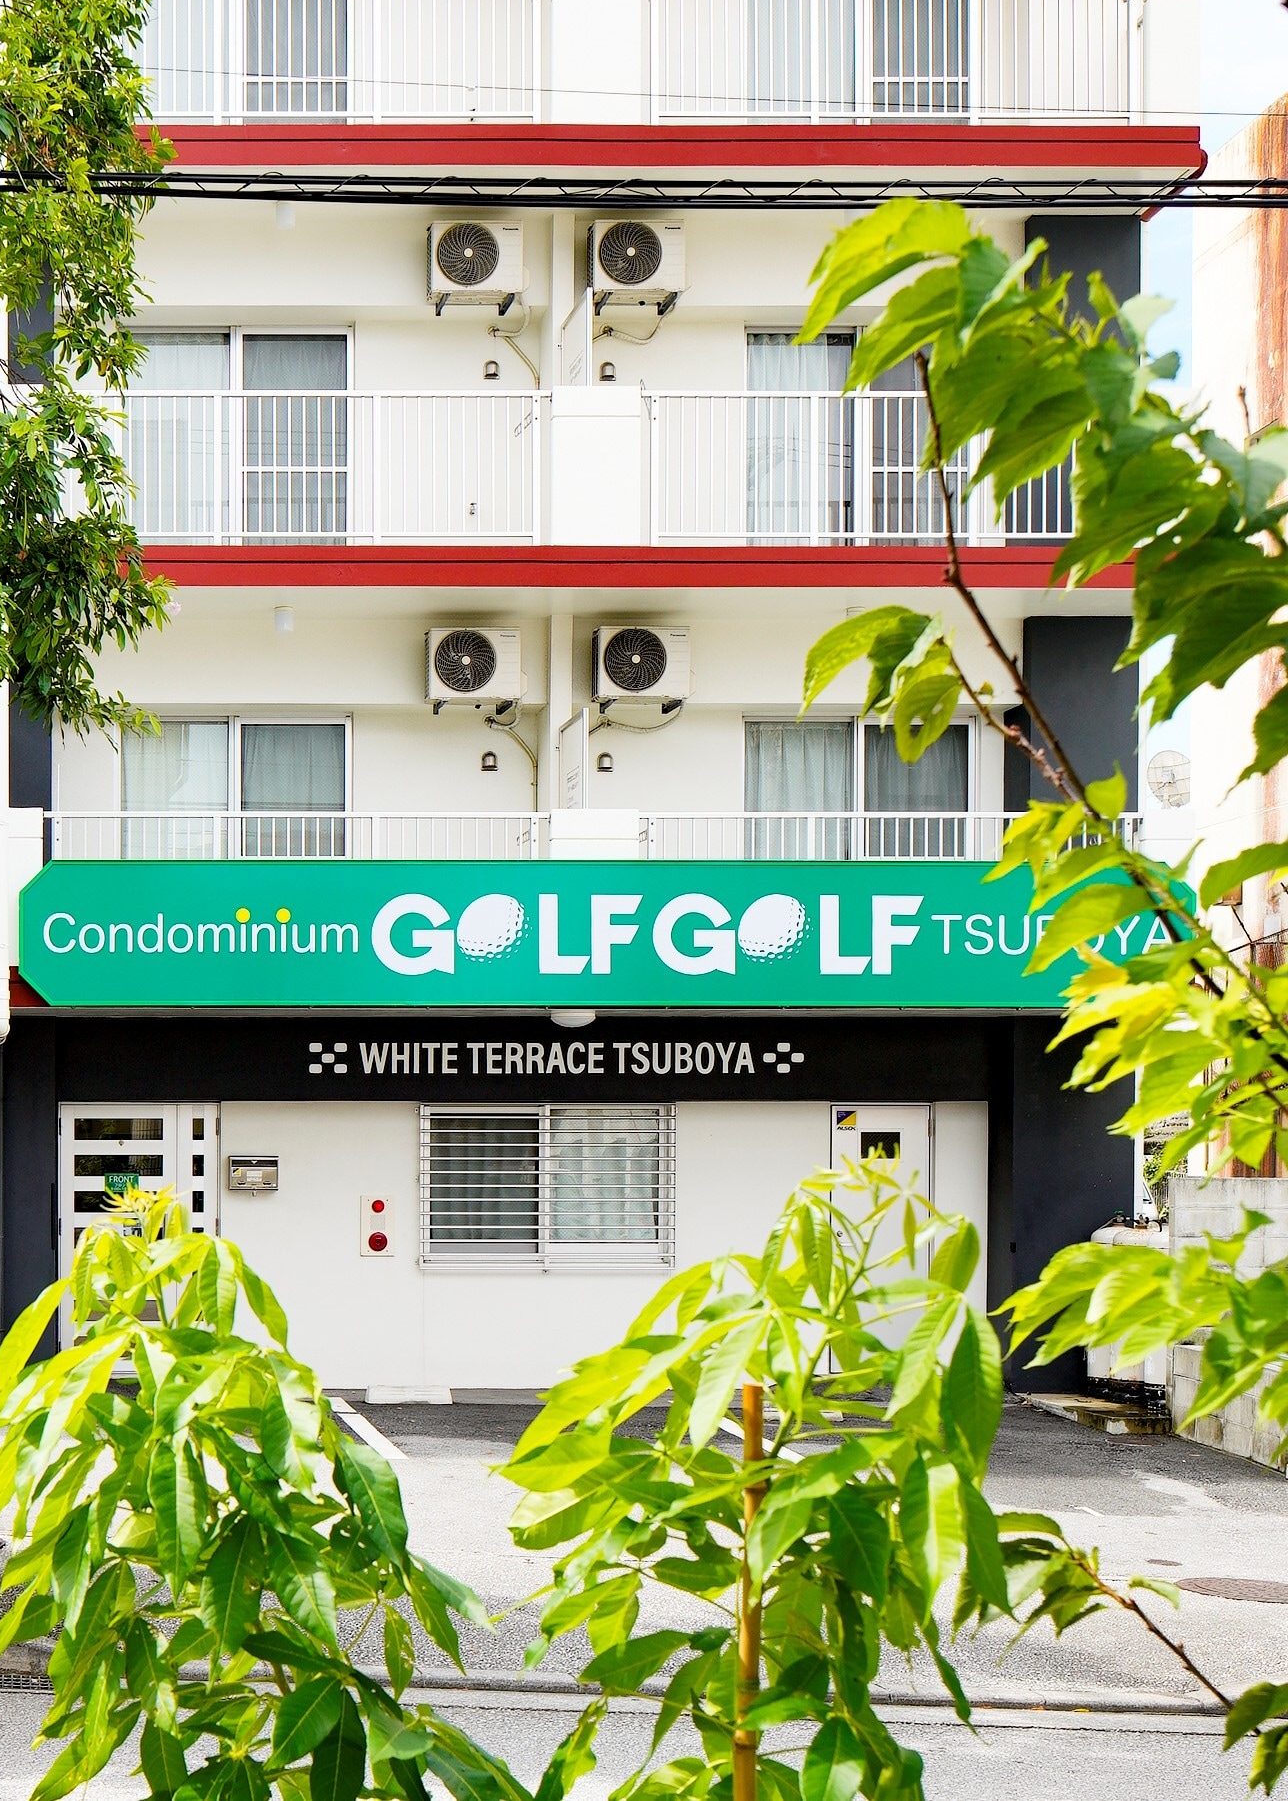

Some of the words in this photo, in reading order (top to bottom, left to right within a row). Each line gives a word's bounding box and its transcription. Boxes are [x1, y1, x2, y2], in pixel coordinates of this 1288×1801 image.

[43, 907, 359, 954] Condominium
[358, 1041, 459, 1075] WHITE
[466, 1041, 605, 1075] TERRACE
[612, 1041, 756, 1075] TSUBOYA
[108, 1175, 135, 1184] FRONT
